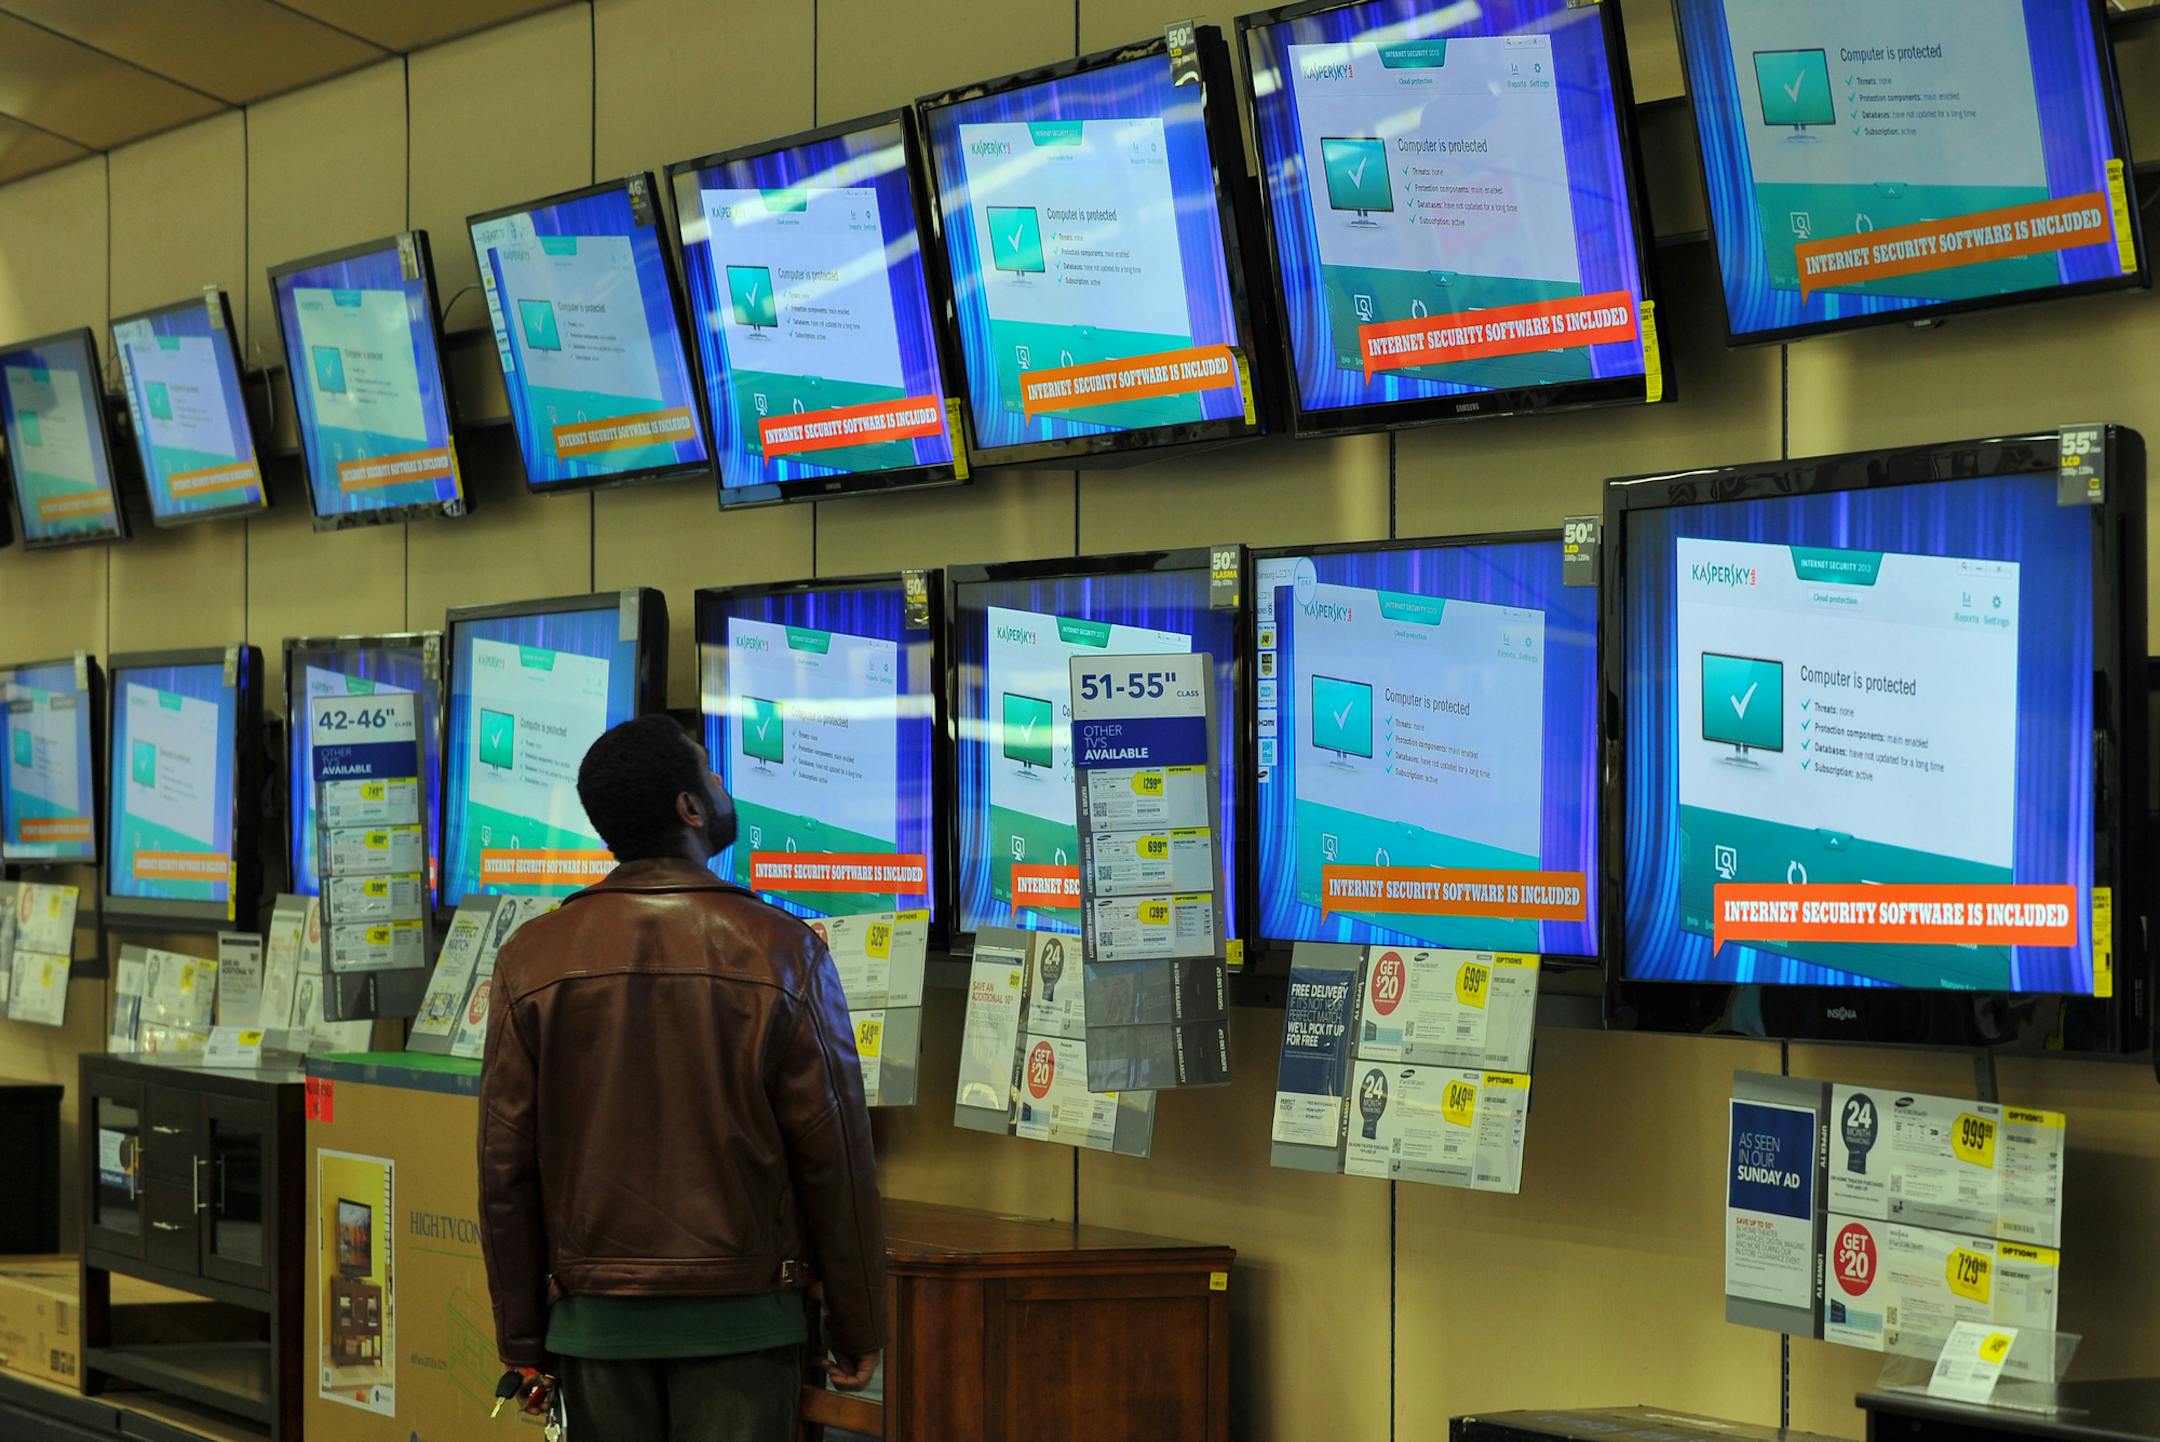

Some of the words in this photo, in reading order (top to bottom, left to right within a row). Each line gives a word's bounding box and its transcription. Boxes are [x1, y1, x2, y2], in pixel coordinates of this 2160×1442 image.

[1840, 47, 1885, 64] Computer
[1886, 46, 1896, 60] is
[1898, 43, 1942, 62] protected
[1398, 138, 1437, 155] Computer
[1439, 138, 1447, 152] is
[1449, 139, 1487, 154] protected
[1047, 208, 1077, 222] Computer
[1086, 209, 1118, 223] protected
[1806, 248, 1870, 275] INTERNET
[1873, 236, 1936, 264] SECURITY
[1940, 223, 2011, 253] SOFTWARE
[2015, 220, 2029, 239] IS
[2031, 208, 2101, 237] INCLUDED
[1368, 334, 1425, 357] INTERNET
[1428, 326, 1484, 350] SECURITY
[1486, 318, 1550, 342] SOFTWARE
[1552, 315, 1564, 333] IS
[1566, 307, 1629, 332] INCLUDED
[1027, 381, 1072, 400] INTERNET
[1074, 372, 1117, 394] SECURITY
[1118, 366, 1169, 388] SOFTWARE
[1170, 365, 1180, 381] IS
[1182, 357, 1229, 379] INCLUDED
[1456, 403, 1480, 413] SAMSUNG
[765, 426, 804, 445] INTERNET
[805, 421, 843, 439] SECURITY
[844, 415, 886, 434] SOFTWARE
[887, 414, 895, 428] IS
[896, 407, 937, 427] INCLUDED
[1565, 523, 1593, 544] 50"
[1213, 552, 1236, 570] 50"
[1801, 559, 1828, 570] INTERNET
[1829, 561, 1856, 572] SECURITY
[1858, 564, 1872, 573] 2013
[1692, 561, 1750, 588] KASPERSKY
[1813, 593, 1829, 604] Cloud
[1830, 594, 1858, 606] protection
[997, 626, 1032, 645] KASPERSKY
[1081, 672, 1176, 700] 51-55"
[1800, 665, 1850, 688] Computer
[1854, 672, 1862, 689] is
[1866, 676, 1916, 696] protected
[1386, 688, 1422, 707] Computer
[1433, 699, 1470, 716] protected
[1814, 702, 1838, 715] Threats:
[1840, 708, 1854, 717] none
[319, 708, 395, 730] 42-46"
[1084, 725, 1122, 738] OTHER
[1814, 722, 1845, 736] Protection
[1846, 729, 1885, 742] components:
[1084, 737, 1107, 748] TV'S
[322, 748, 352, 757] OTHER
[1084, 748, 1149, 760] AVAILABLE
[322, 764, 372, 776] AVAILABLE
[1865, 752, 1874, 761] not
[1916, 759, 1929, 772] long
[1930, 760, 1944, 772] time
[756, 863, 792, 879] INTERNET
[794, 864, 831, 880] SECURITY
[832, 864, 873, 881] SOFTWARE
[884, 866, 923, 882] INCLUDED
[1018, 877, 1062, 894] INTERNET
[1329, 878, 1384, 898] INTERNET
[1386, 881, 1440, 900] SECURITY
[1443, 882, 1505, 903] SOFTWARE
[1508, 885, 1518, 904] IS
[1521, 885, 1580, 906] INCLUDED
[1724, 900, 1799, 923] INTERNET
[1802, 902, 1877, 924] SECURITY
[1880, 903, 1964, 926] SOFTWARE
[1968, 904, 1984, 926] IS
[1986, 904, 2069, 927] INCLUDED
[1045, 944, 1061, 965] 24
[1496, 956, 1522, 965] OPTIONS
[1380, 961, 1400, 975] GET
[973, 982, 985, 991] SAVE
[985, 983, 993, 992] AN
[1291, 984, 1311, 997] FREE
[1311, 984, 1348, 999] DELIVERY
[1376, 976, 1398, 999] $20
[972, 992, 1003, 1003] ADDITIONAL
[1308, 998, 1324, 1010] NOT
[1289, 1010, 1317, 1022] PERFECT
[1288, 1022, 1307, 1034] WE'LL
[1309, 1022, 1325, 1035] PICK
[1334, 1025, 1345, 1037] UP
[1286, 1034, 1301, 1046] FOR
[1301, 1035, 1319, 1047] FREE
[1035, 1050, 1051, 1063] GET
[1032, 1063, 1050, 1084] $20
[1364, 1076, 1383, 1099] 24
[1847, 1101, 1872, 1129] 24
[2008, 1112, 2044, 1123] OPTIONS
[1739, 1132, 1752, 1149] AS
[1755, 1134, 1780, 1152] SEEN
[1739, 1150, 1749, 1165] IN
[1752, 1152, 1775, 1168] OUR
[1820, 1158, 1826, 1168] TV
[1738, 1166, 1782, 1186] SUNDAY
[1784, 1172, 1800, 1189] AD
[410, 1212, 439, 1238] HIGH
[440, 1216, 456, 1239] TV
[1842, 1232, 1868, 1250] GET
[2002, 1248, 2038, 1259] OPTIONS
[1840, 1251, 1868, 1278] $20
[1816, 1288, 1823, 1300] TV
